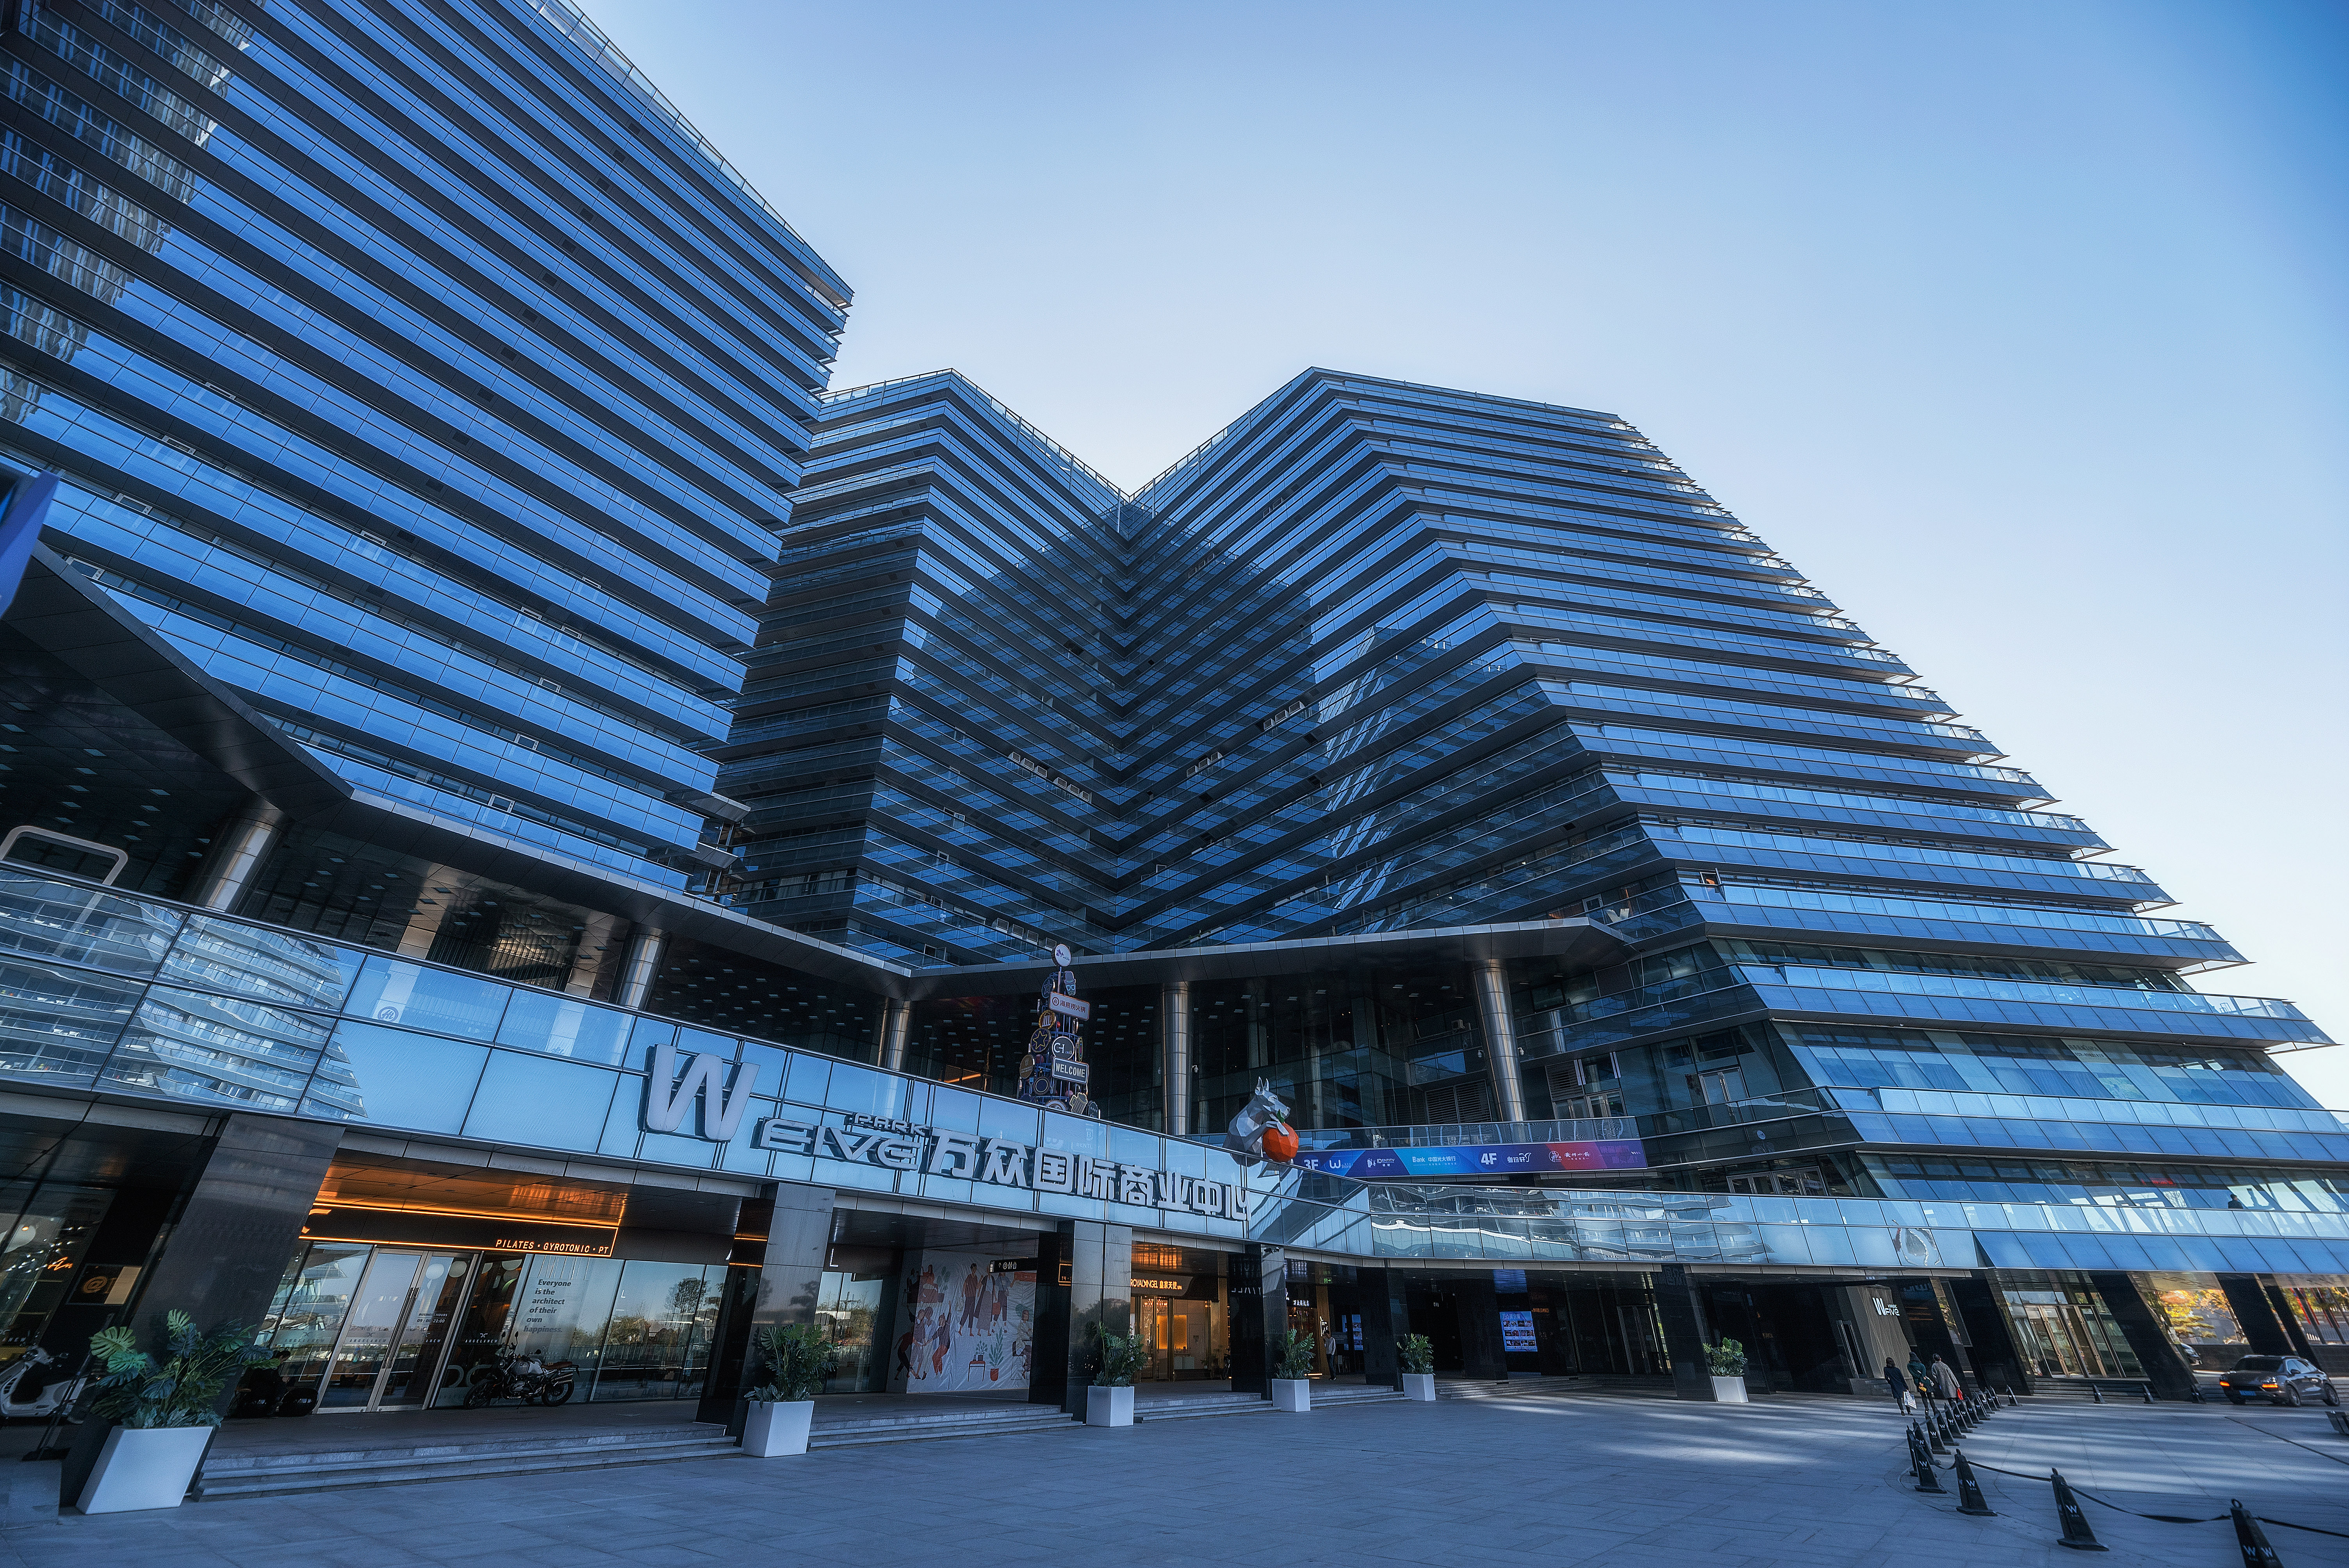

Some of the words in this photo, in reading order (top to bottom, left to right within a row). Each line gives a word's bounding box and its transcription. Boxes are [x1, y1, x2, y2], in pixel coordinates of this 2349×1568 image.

[1060, 1000, 1086, 1013] 海底捞火锅
[1055, 1062, 1085, 1078] WELCOME
[646, 1043, 760, 1141] W
[854, 1112, 927, 1136] PARK
[1304, 1159, 1319, 1170] 3F
[1481, 1153, 1497, 1165] 4F
[927, 1127, 1251, 1221] 万众国际商业中心
[495, 1239, 535, 1249] PILATES
[543, 1242, 590, 1253] GYROTONIC
[538, 1279, 572, 1288] Everyone
[1159, 1280, 1177, 1290] 皇家天使
[523, 1326, 563, 1334] happiness.
[2065, 1504, 2077, 1514] W
[2242, 1545, 2256, 1557] W
[2260, 1547, 2273, 1557] W
